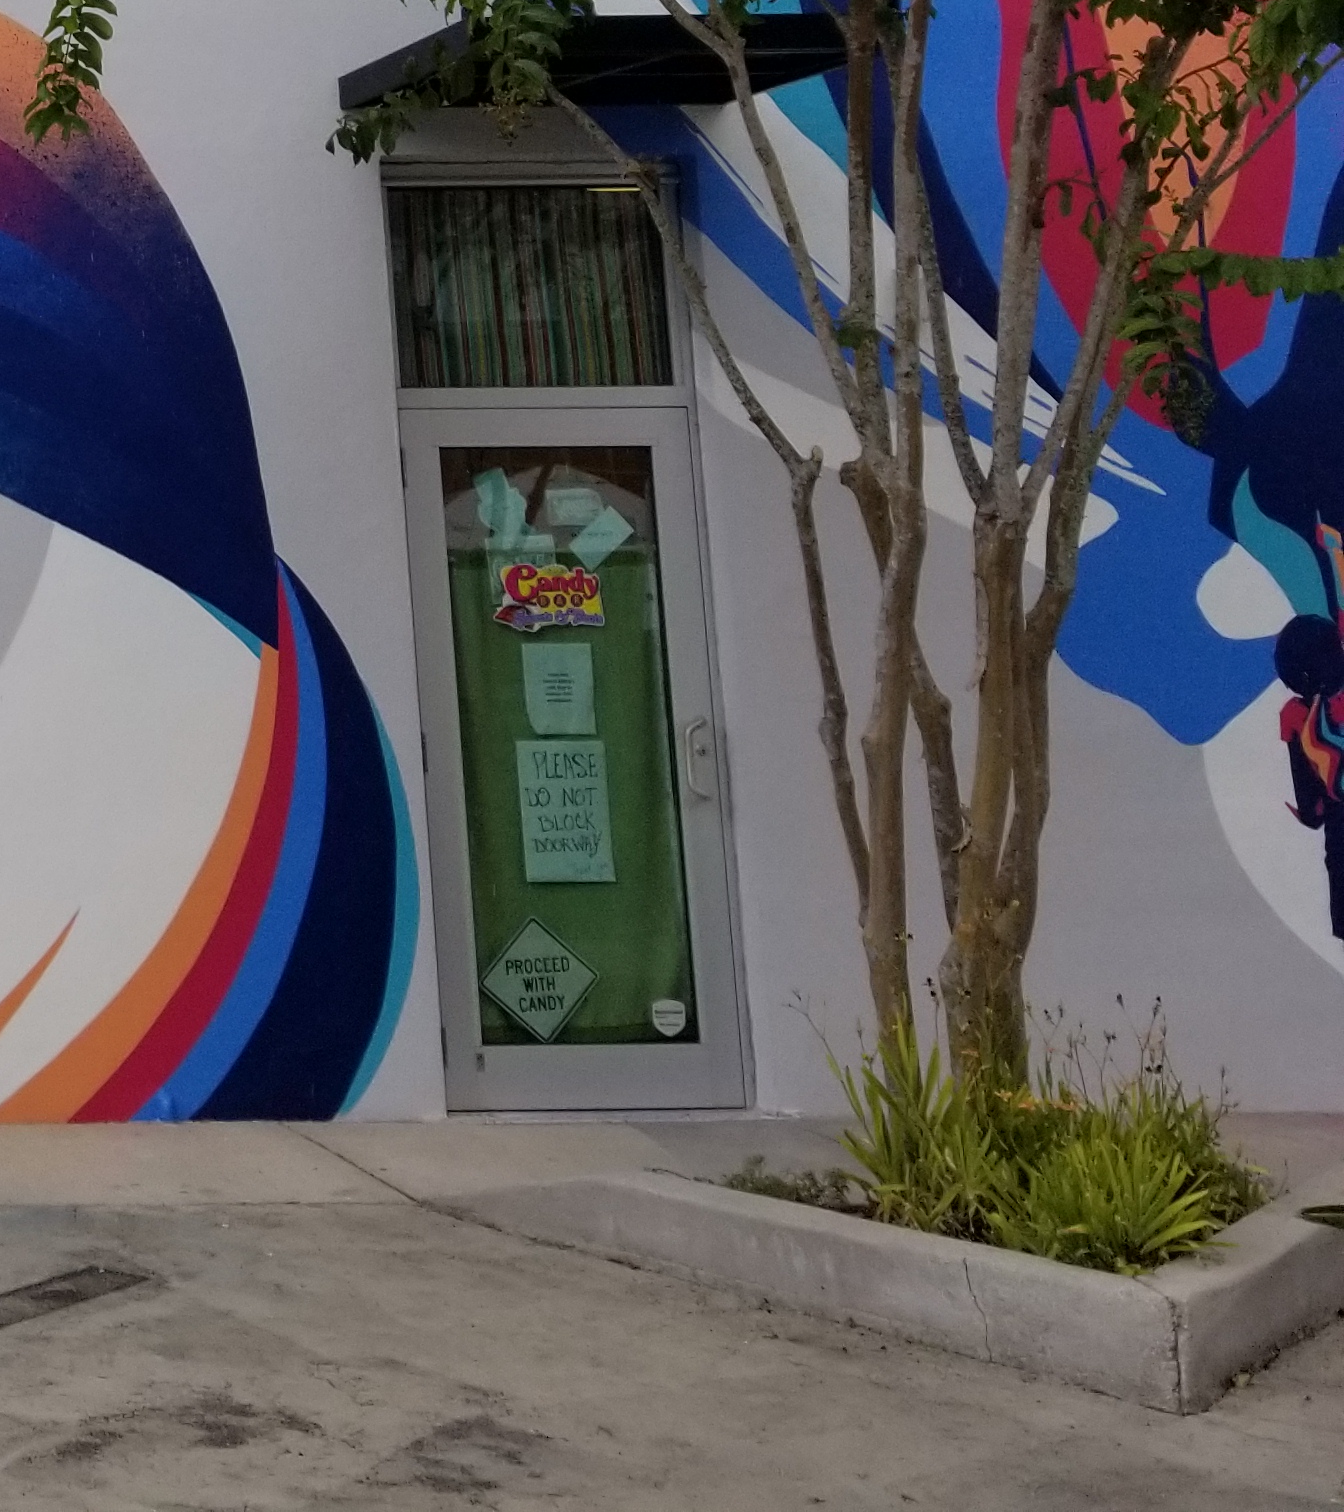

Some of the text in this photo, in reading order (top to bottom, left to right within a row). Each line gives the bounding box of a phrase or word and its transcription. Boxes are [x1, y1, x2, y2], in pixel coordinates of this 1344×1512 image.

[504, 564, 600, 603] Candy
[533, 750, 599, 779] PLEASE
[524, 787, 598, 807] DO NOT
[537, 809, 596, 833] BLOCK
[505, 955, 570, 976] PROCEED
[522, 976, 556, 993] WITH
[518, 995, 566, 1014] CANDY
